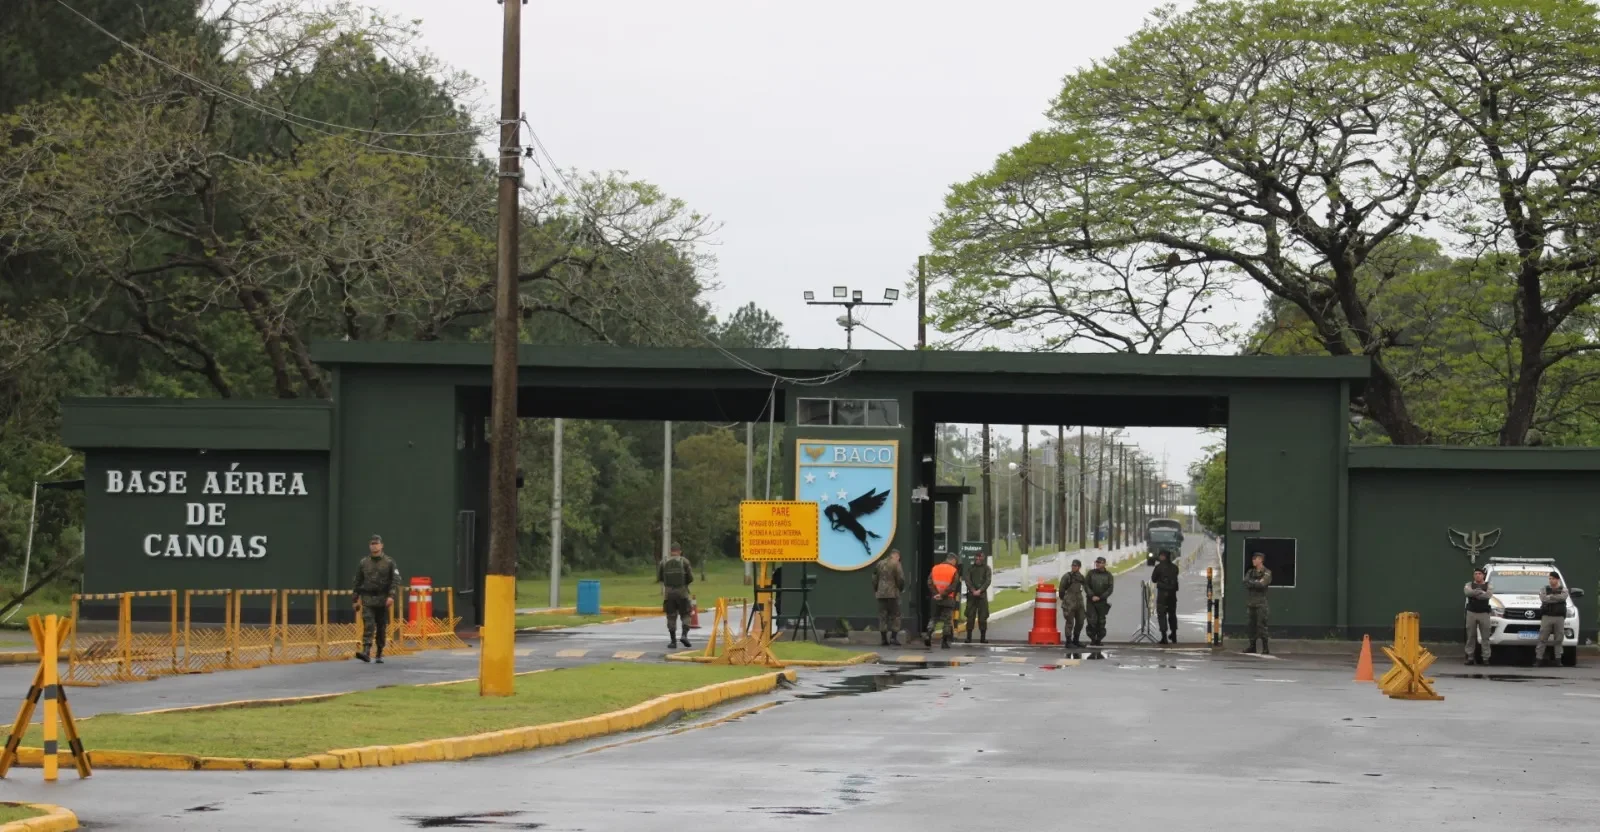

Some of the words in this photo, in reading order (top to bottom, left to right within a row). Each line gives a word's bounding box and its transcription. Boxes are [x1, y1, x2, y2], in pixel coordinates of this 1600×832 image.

[833, 446, 892, 463] BACO
[106, 470, 187, 494] BASE
[202, 462, 309, 496] AÉREA
[186, 502, 226, 526] DE
[771, 506, 790, 517] PARE
[143, 533, 268, 559] CANOAS
